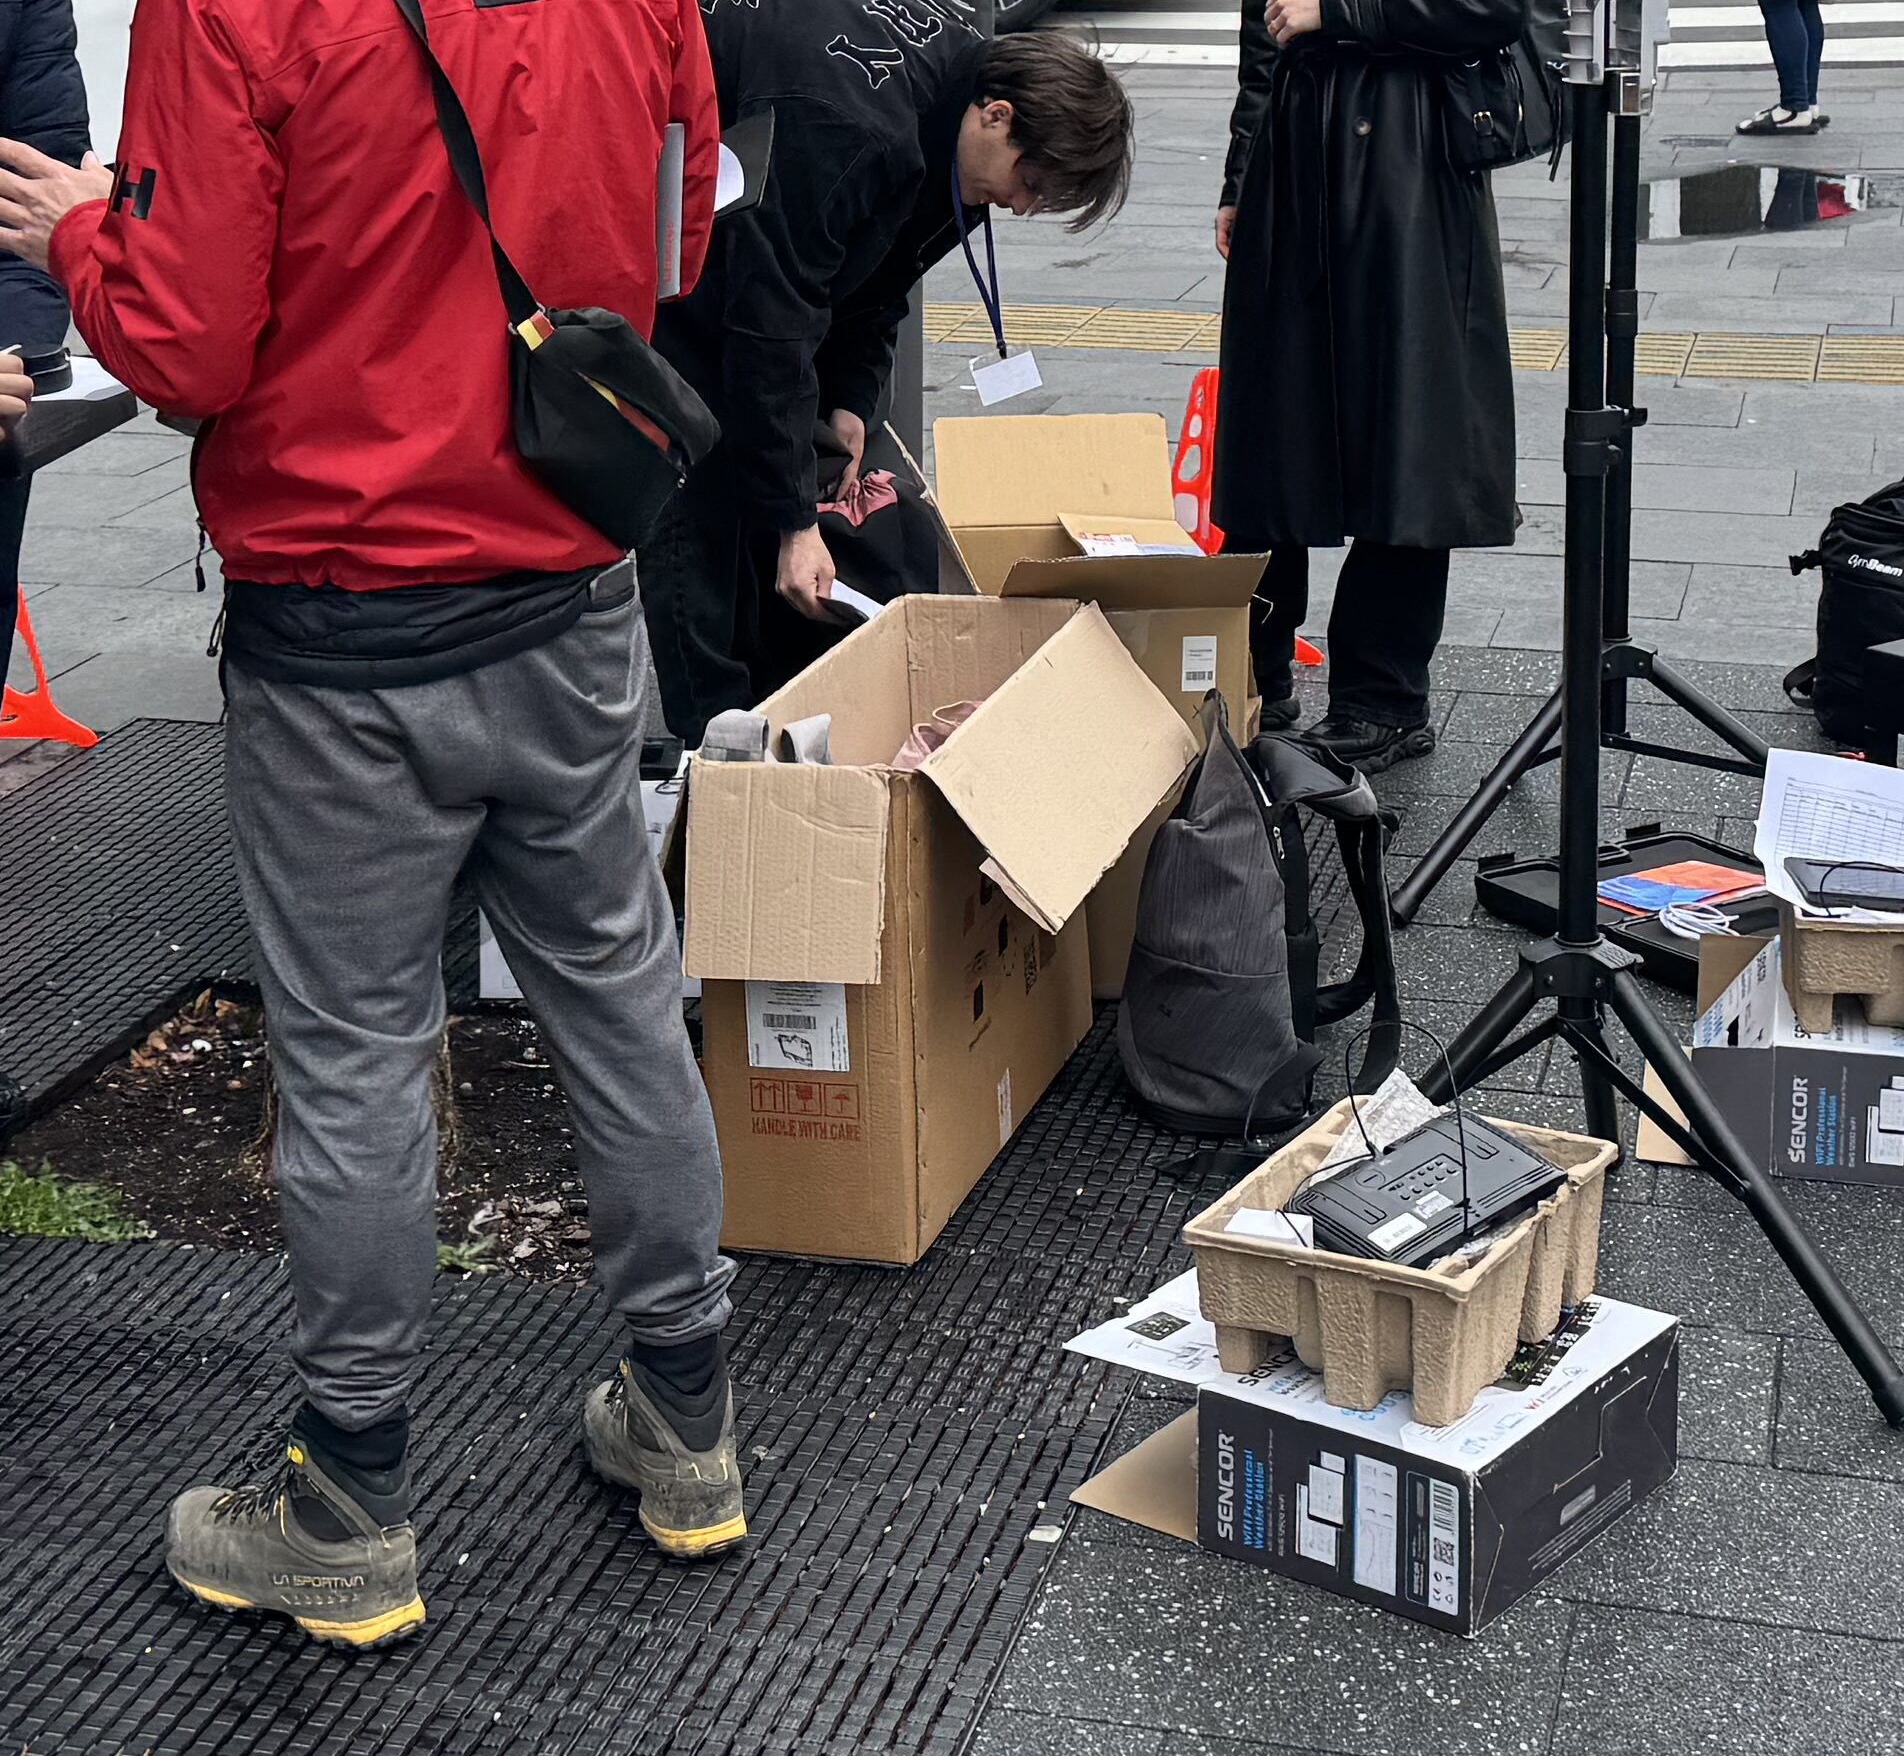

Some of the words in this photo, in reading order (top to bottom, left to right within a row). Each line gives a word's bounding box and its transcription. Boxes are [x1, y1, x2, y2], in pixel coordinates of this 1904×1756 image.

[751, 1117, 796, 1137] HANDLE
[799, 1121, 828, 1140] WITH
[830, 1123, 862, 1142] CARE
[1788, 1077, 1808, 1163] SENCOR
[1827, 1094, 1837, 1126] Station
[1825, 1128, 1836, 1166] Weather
[1238, 1347, 1298, 1387] SENC
[1217, 1432, 1235, 1542] SENCOR
[1254, 1503, 1265, 1549] Weather
